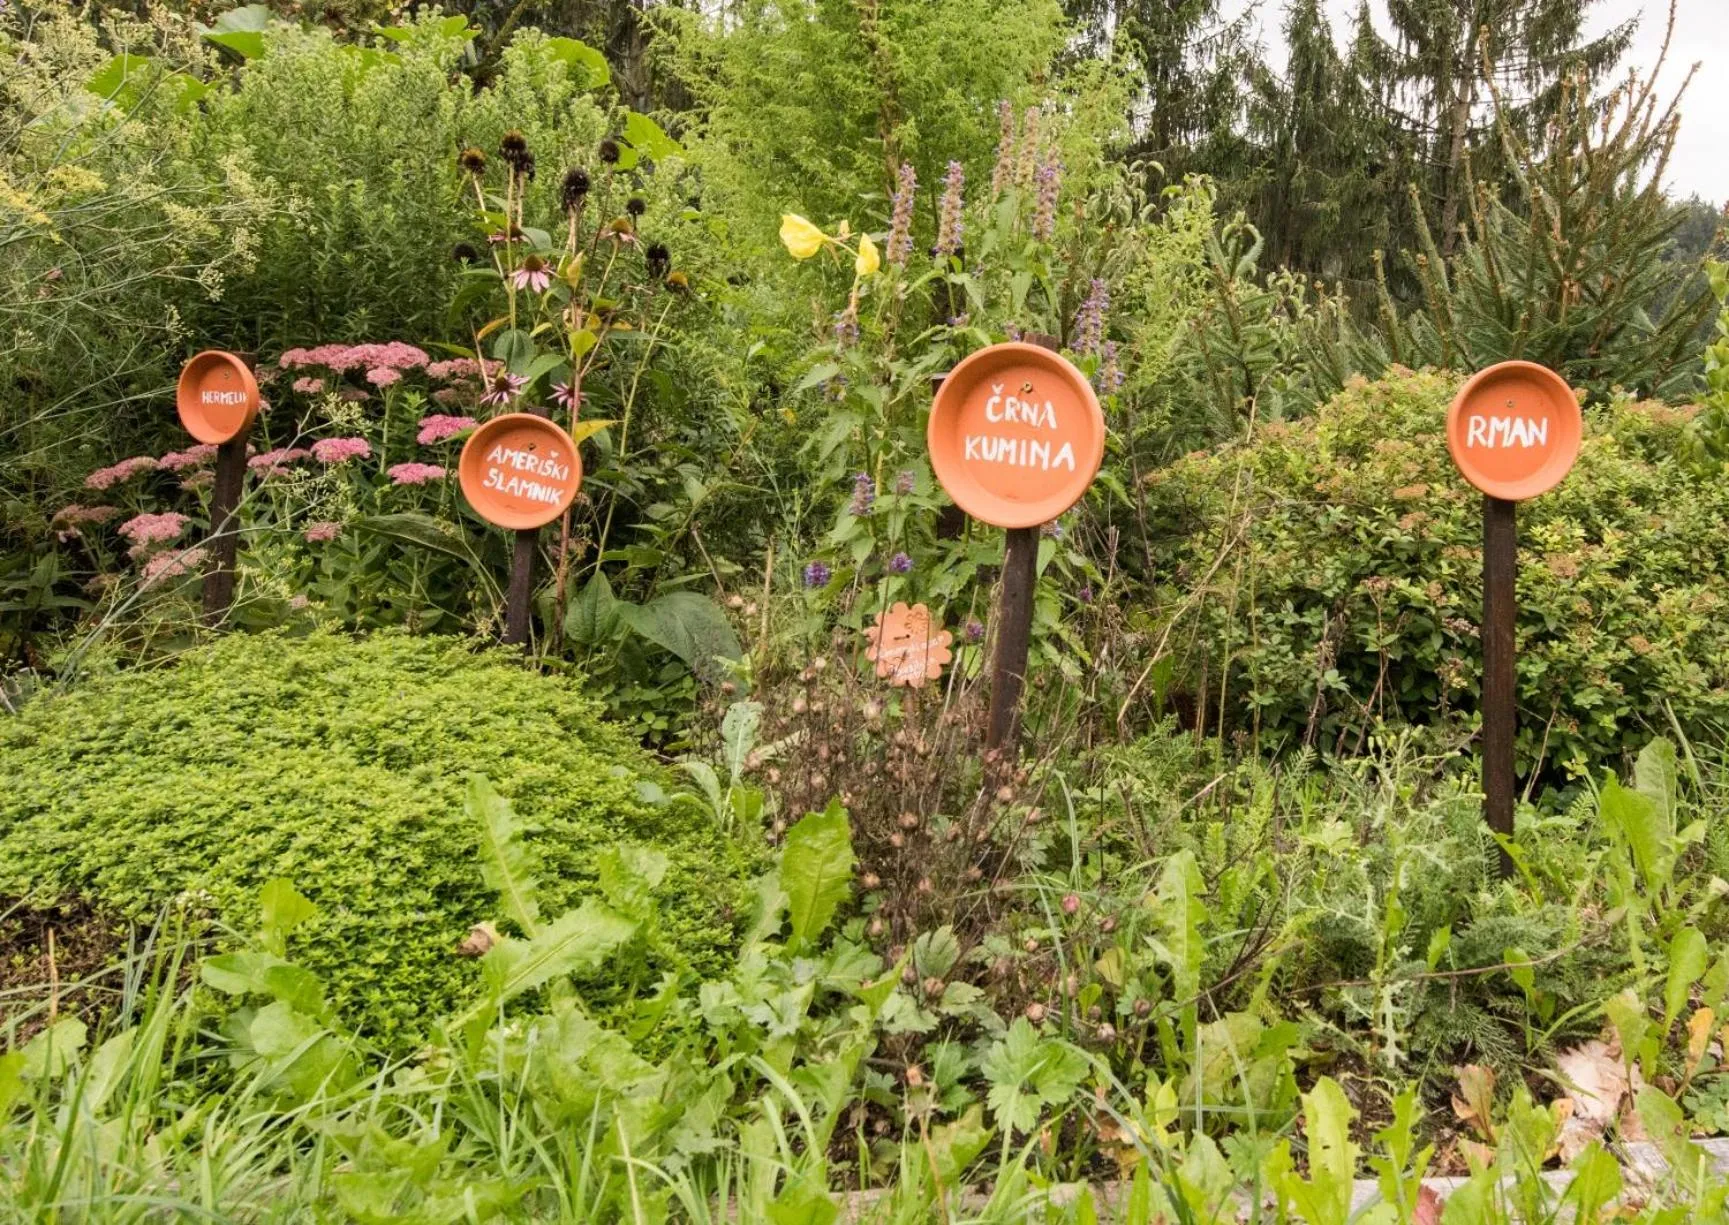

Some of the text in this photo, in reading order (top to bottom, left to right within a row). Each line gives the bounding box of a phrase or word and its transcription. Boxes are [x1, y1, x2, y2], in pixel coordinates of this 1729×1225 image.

[985, 383, 1057, 429] ČRNA
[1467, 415, 1548, 448] RMAN
[486, 444, 569, 481] AMERIŠKI
[965, 436, 1076, 472] KUMINA
[483, 467, 564, 505] SLAMNIK
